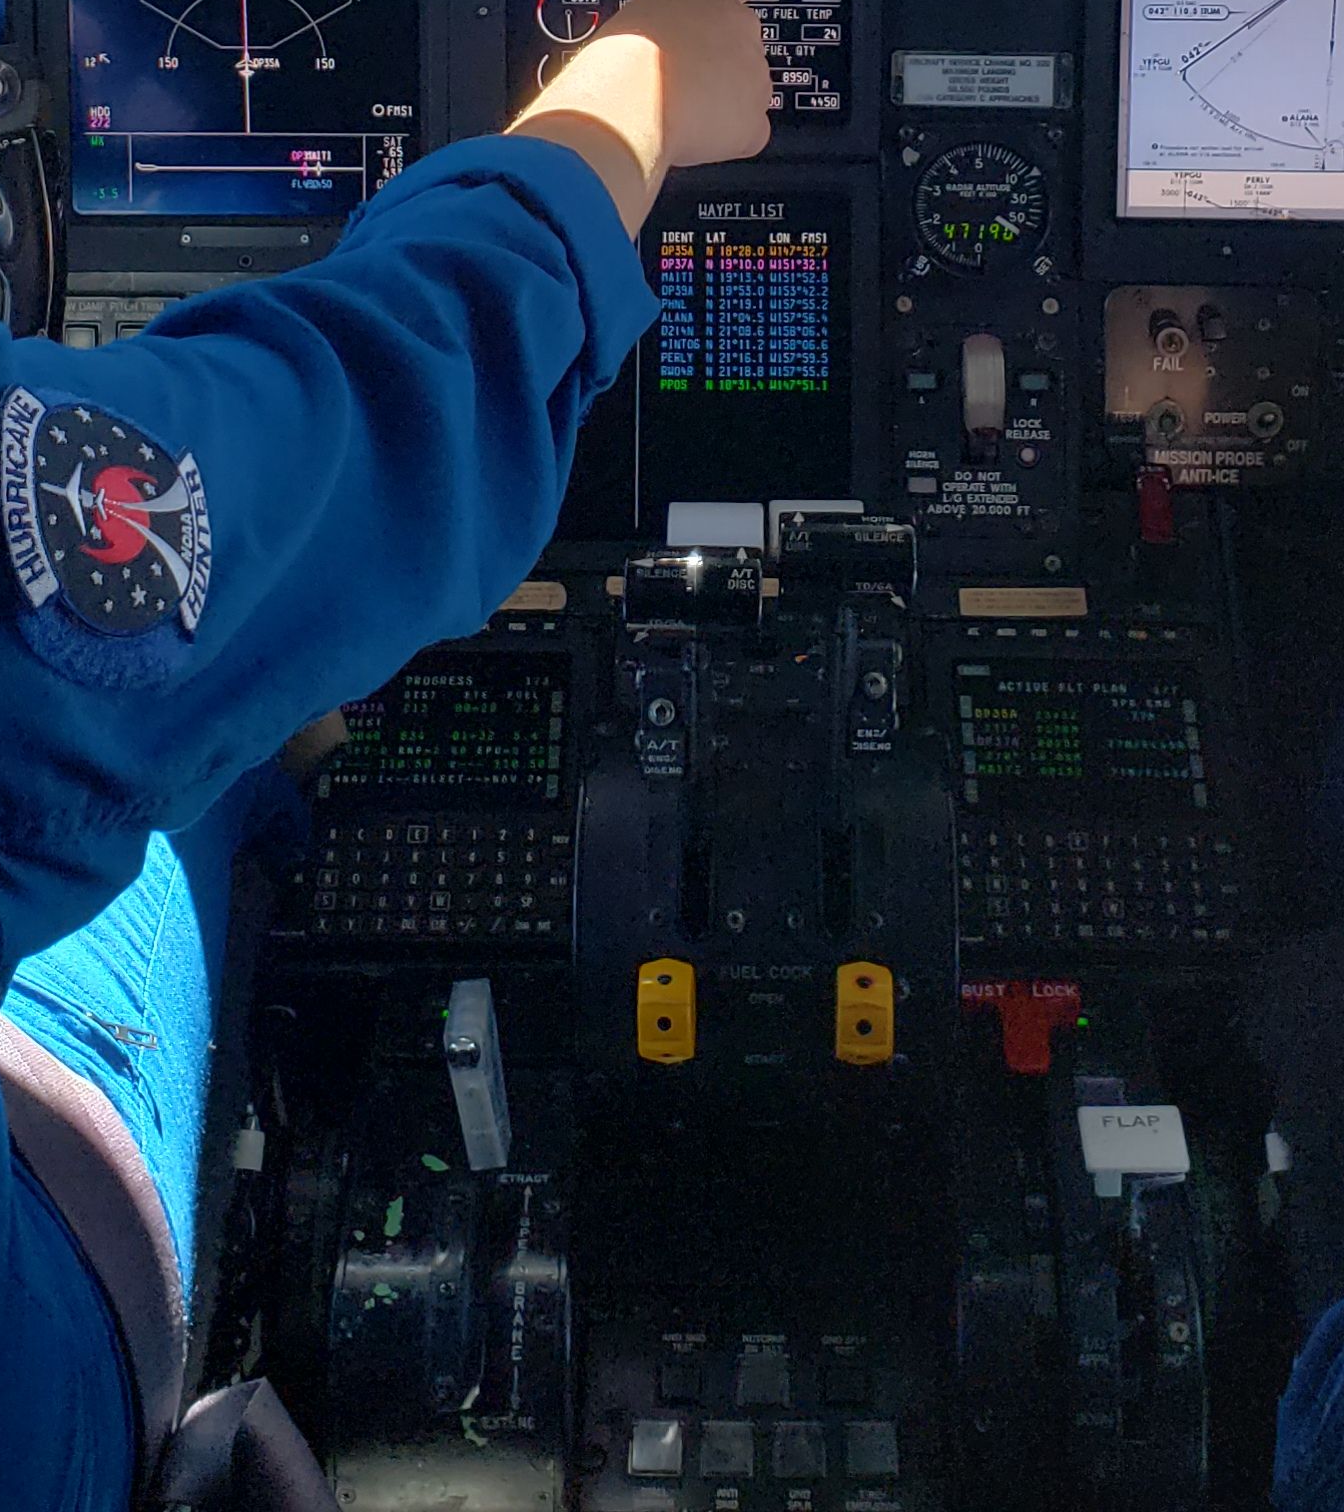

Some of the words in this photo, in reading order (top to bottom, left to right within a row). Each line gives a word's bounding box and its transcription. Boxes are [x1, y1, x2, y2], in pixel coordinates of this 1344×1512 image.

[773, 8, 800, 19] FUEL
[806, 8, 833, 20] TEMP
[764, 45, 790, 56] FUEL
[795, 45, 816, 56] QTY
[158, 56, 179, 69] 150
[315, 58, 335, 70] 150
[810, 96, 837, 107] 4450
[698, 203, 742, 218] WAYPT
[750, 203, 785, 218] LIST
[662, 231, 694, 243] IDENT
[705, 232, 726, 243] LAT
[769, 232, 791, 244] LON
[801, 233, 827, 244] FMS1
[661, 272, 693, 283] MAITI
[661, 312, 694, 323] ALANA
[1153, 357, 1184, 371] FAIL
[1013, 418, 1042, 429] LOCK
[1204, 412, 1248, 425] POWER
[1006, 429, 1051, 439] RELEASE
[1154, 451, 1213, 466] MISSION
[1216, 451, 1265, 466] PROBE
[1179, 469, 1240, 484] ANTI-ICE
[6, 394, 47, 585] HURRICANE
[180, 513, 194, 562] NOAA
[187, 468, 212, 619] HUNTER
[1033, 984, 1077, 997] LOCK
[1103, 1115, 1160, 1128] FLAP
